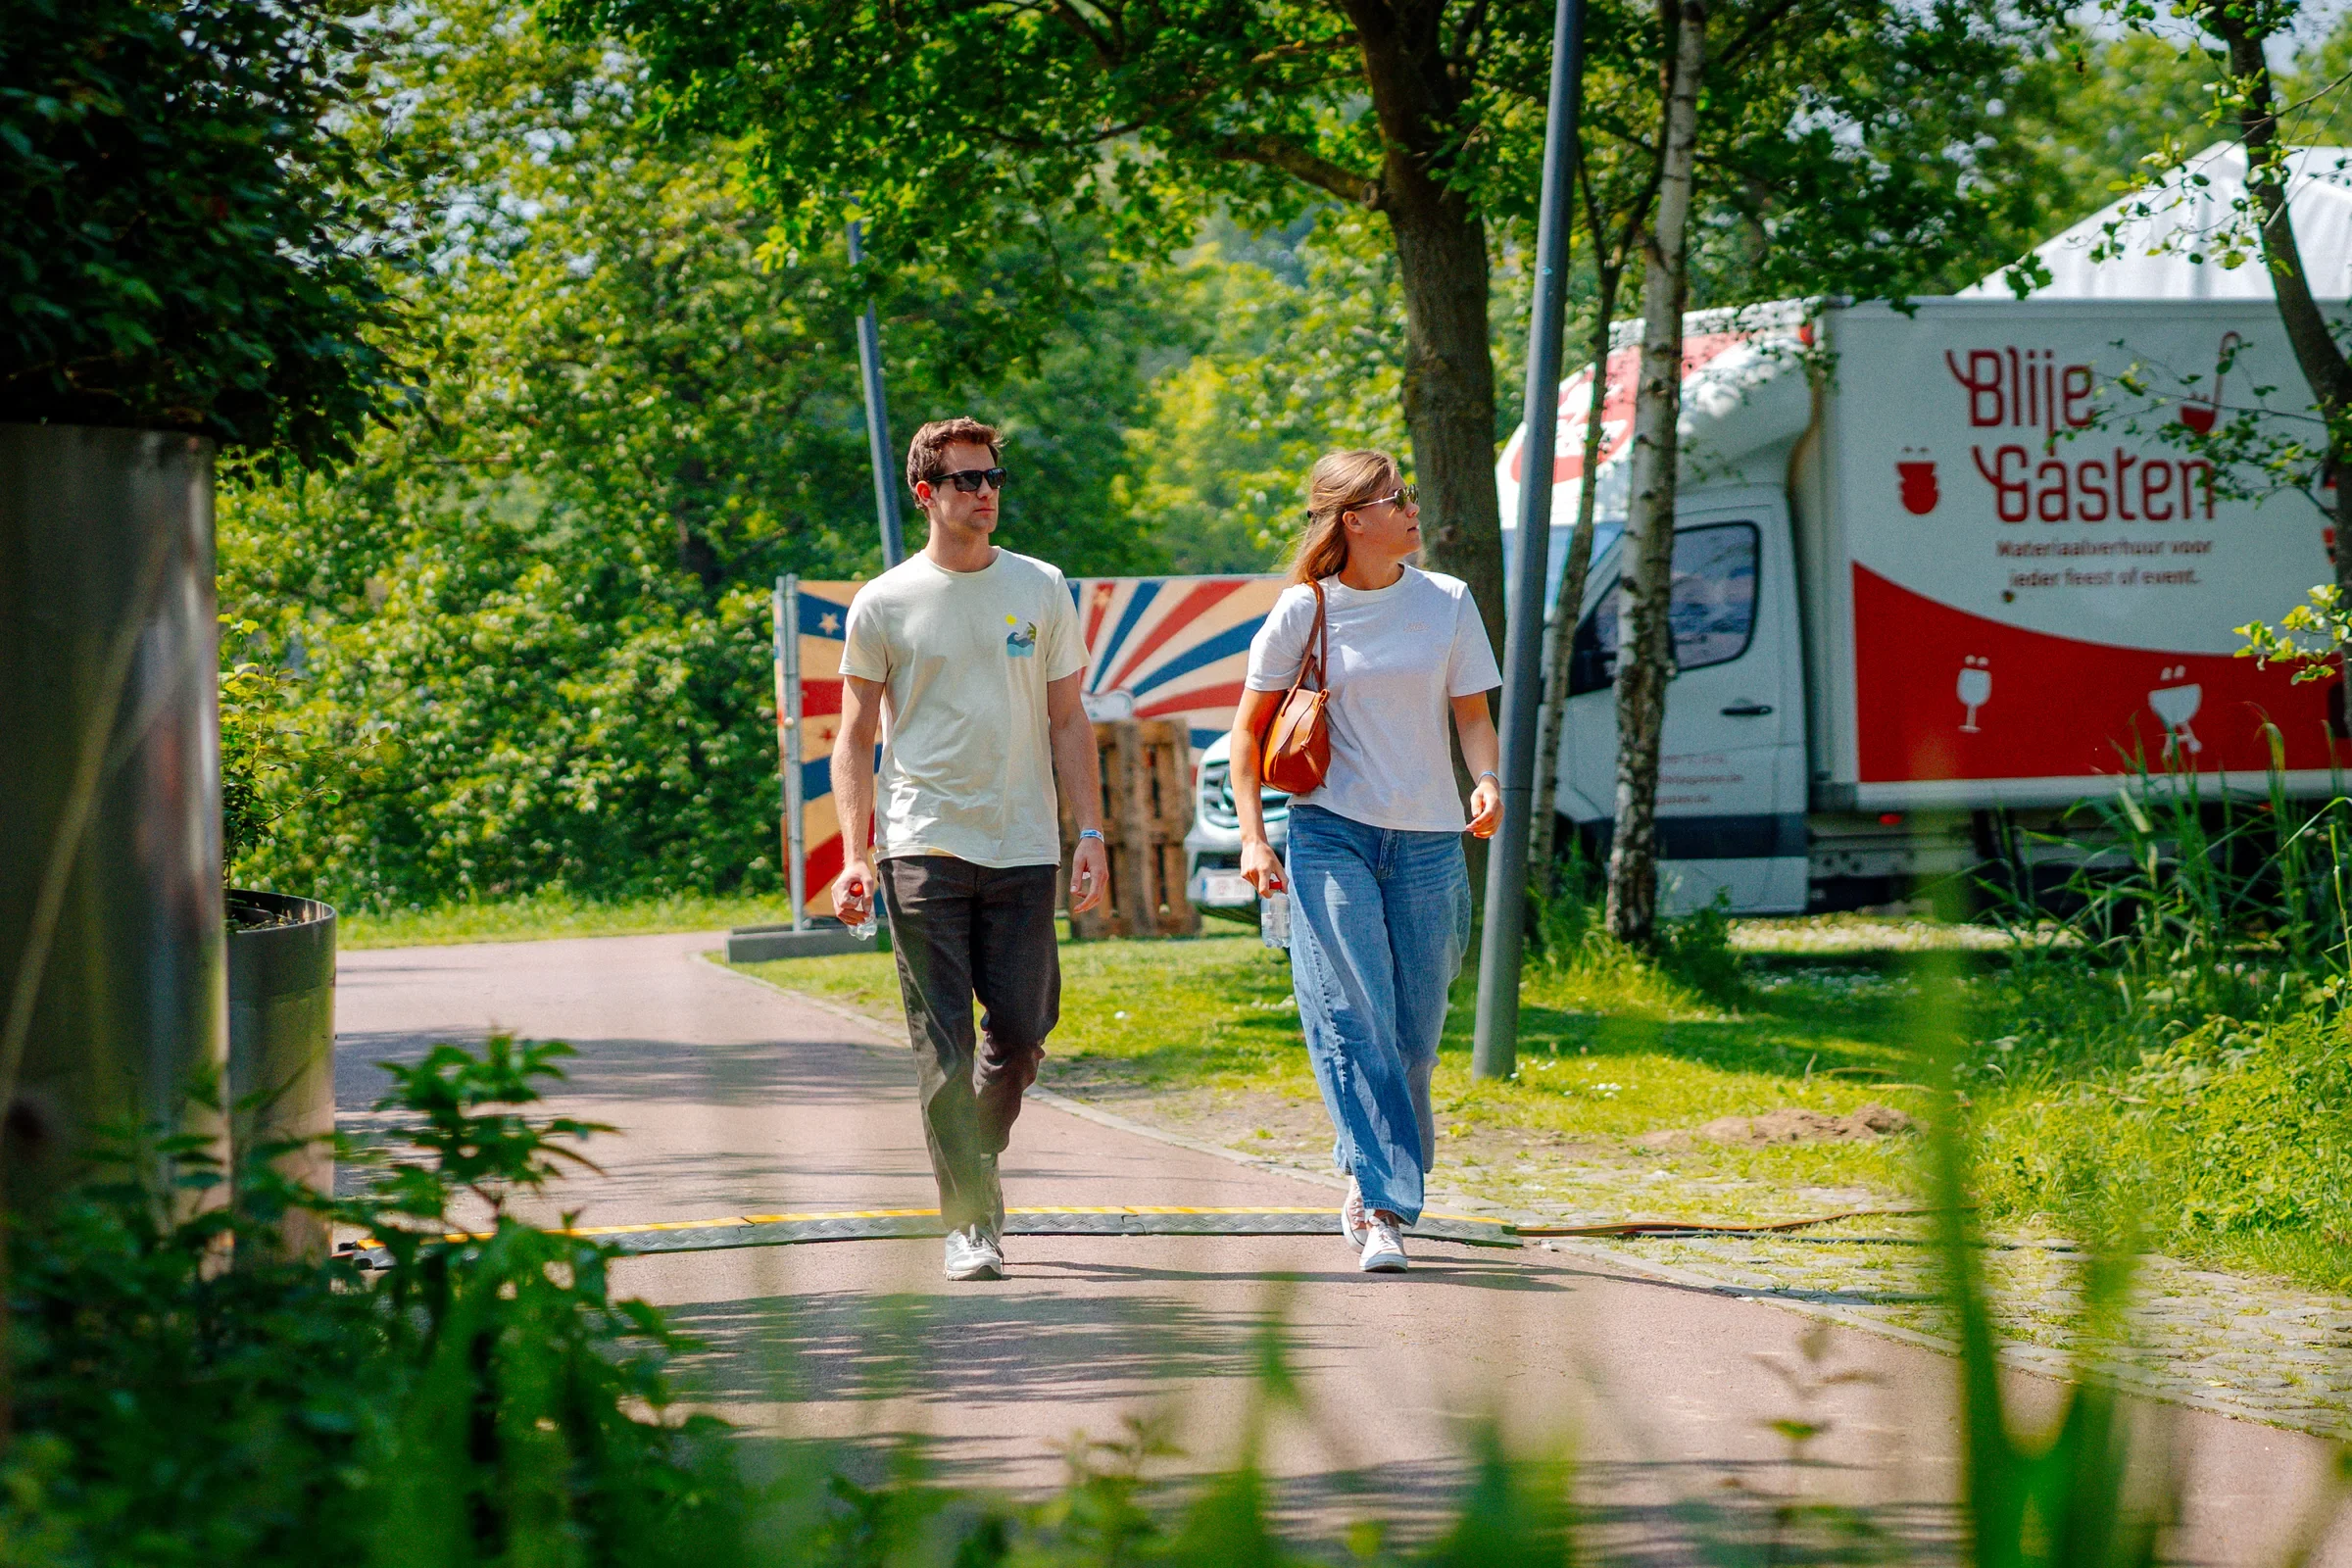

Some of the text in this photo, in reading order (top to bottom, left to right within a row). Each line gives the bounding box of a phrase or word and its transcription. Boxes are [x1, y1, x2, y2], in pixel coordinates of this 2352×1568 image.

[1945, 346, 2094, 458] Blije
[1971, 444, 2215, 522] Gasten
[1995, 538, 2213, 557] Materiaalverhuur voor
[2064, 566, 2113, 585] feest
[2117, 565, 2138, 584] of
